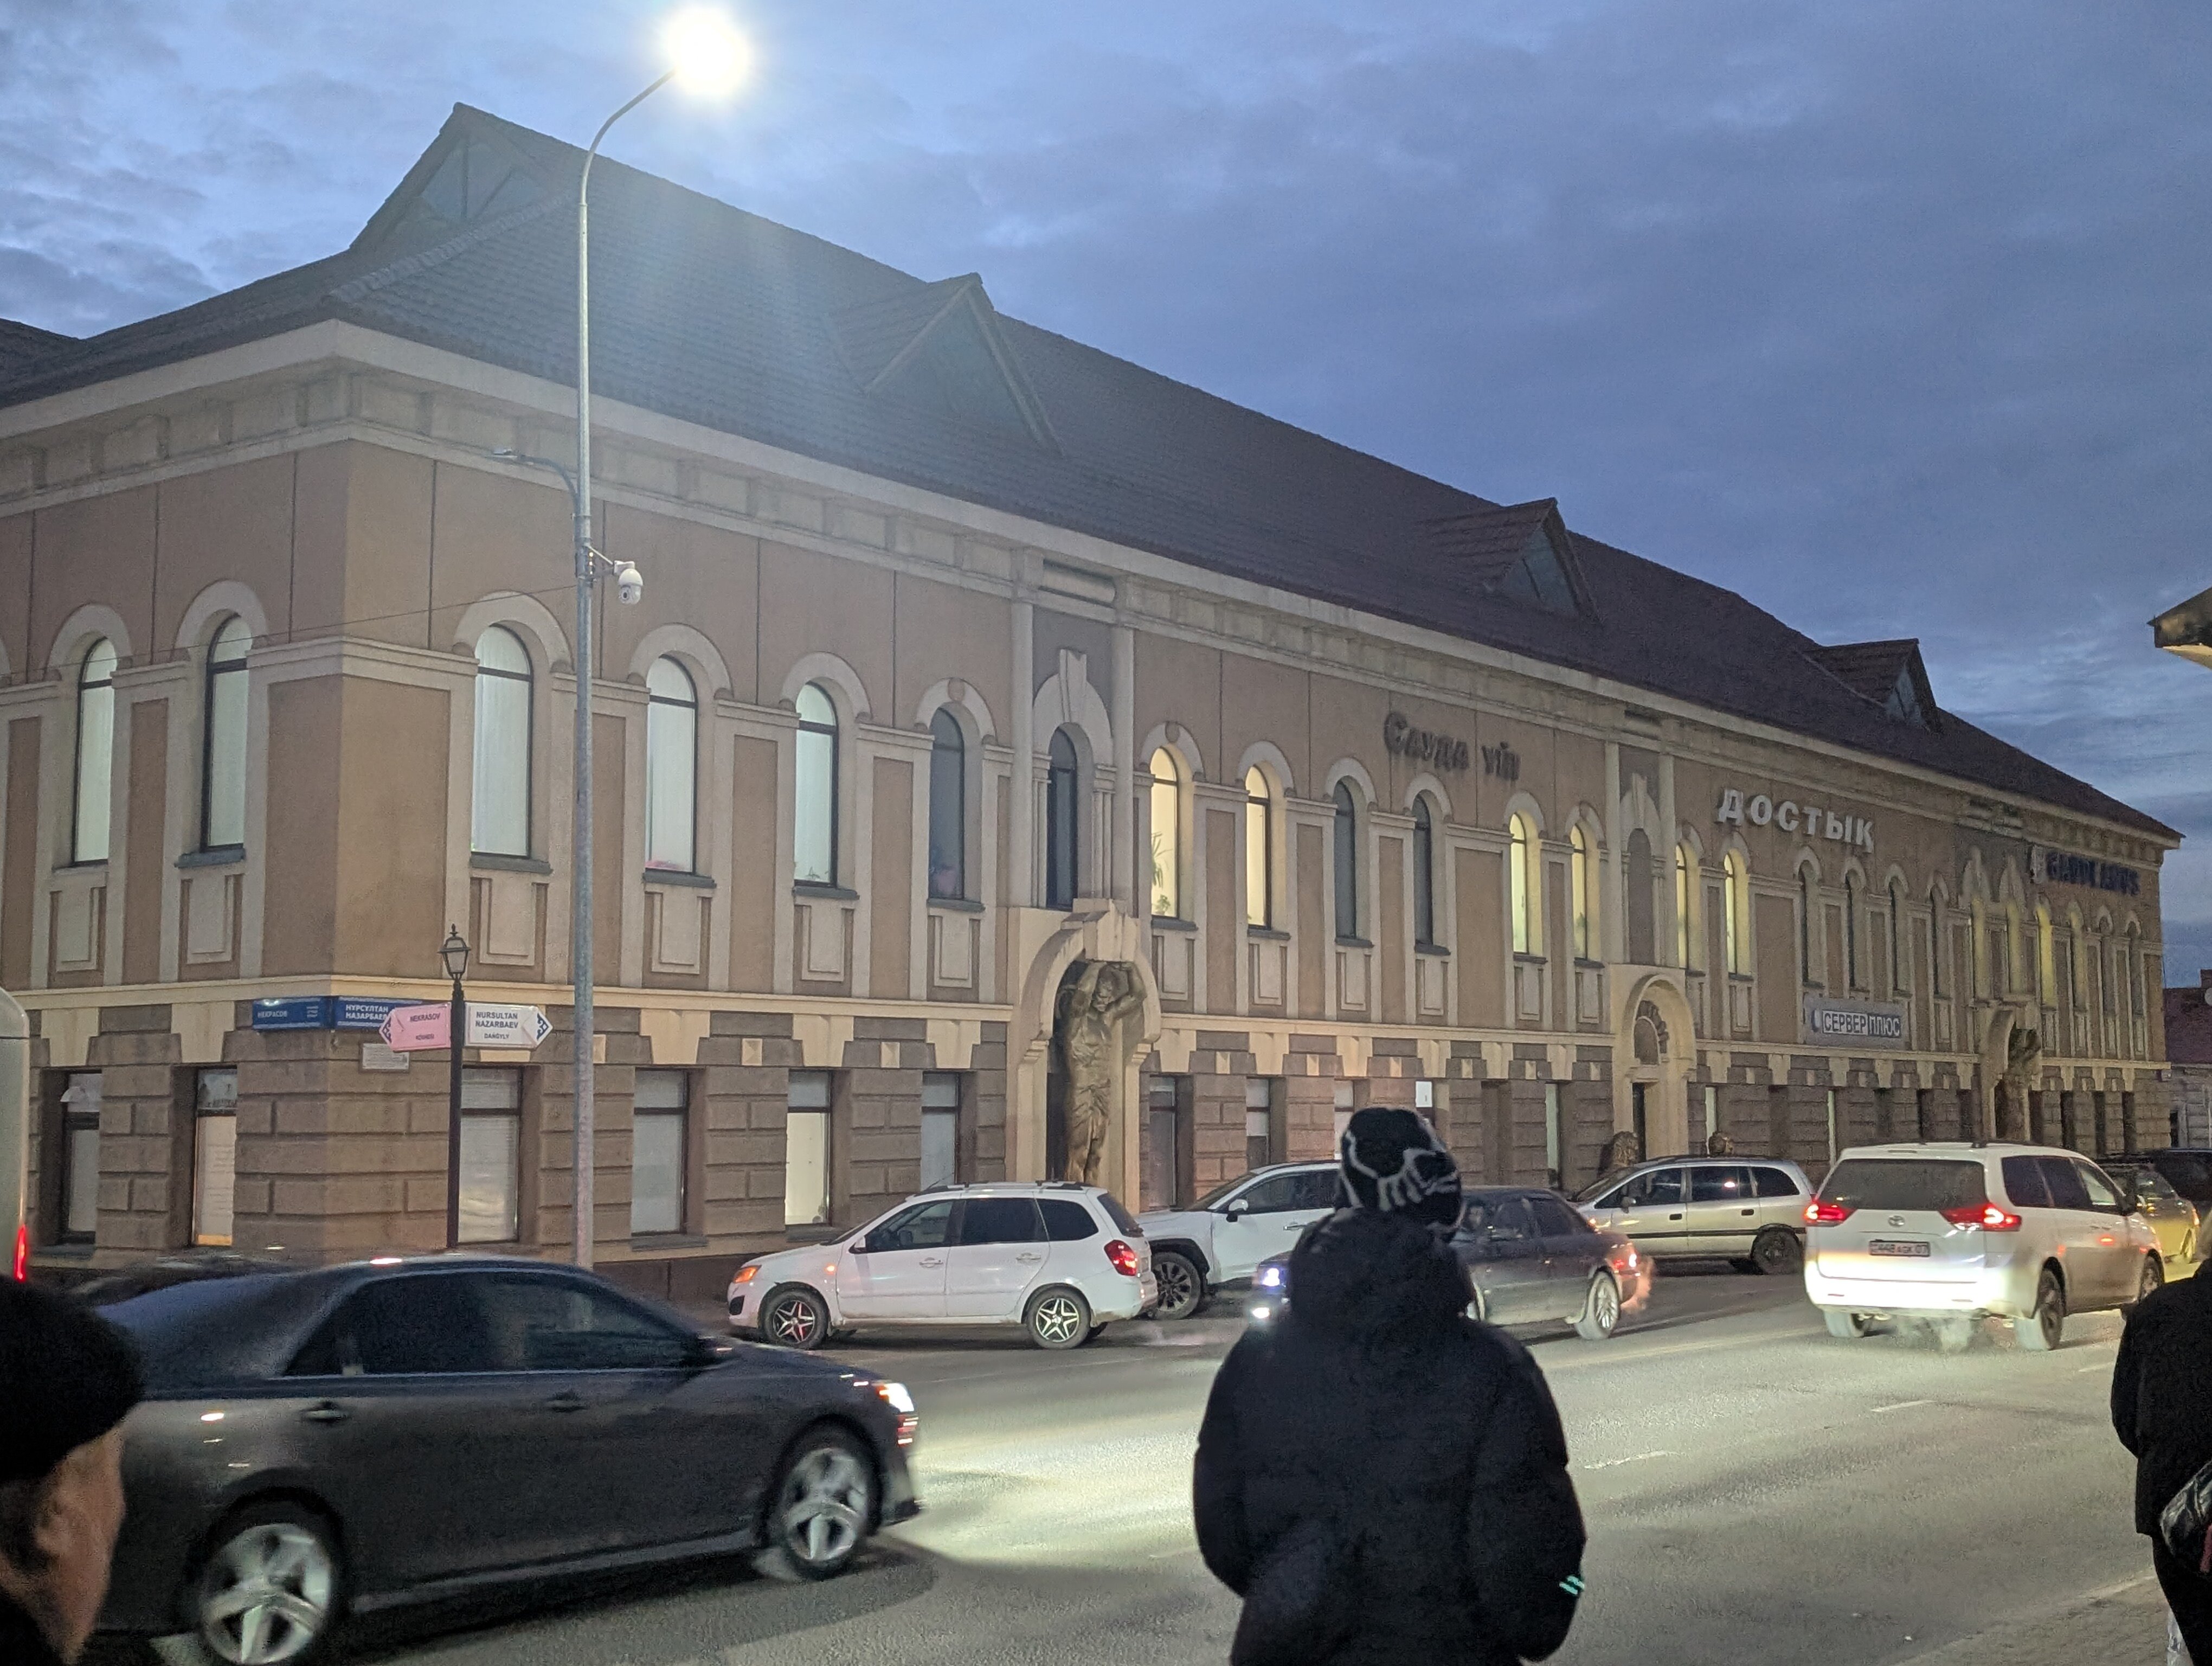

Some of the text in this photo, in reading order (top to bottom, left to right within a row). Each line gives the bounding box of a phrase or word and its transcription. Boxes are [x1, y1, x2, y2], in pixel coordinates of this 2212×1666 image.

[410, 1013, 441, 1022] NEKRASOV
[475, 1019, 519, 1029] NAZARBAEV
[1824, 1013, 1900, 1036] СЕРВЕР ПЛЮС
